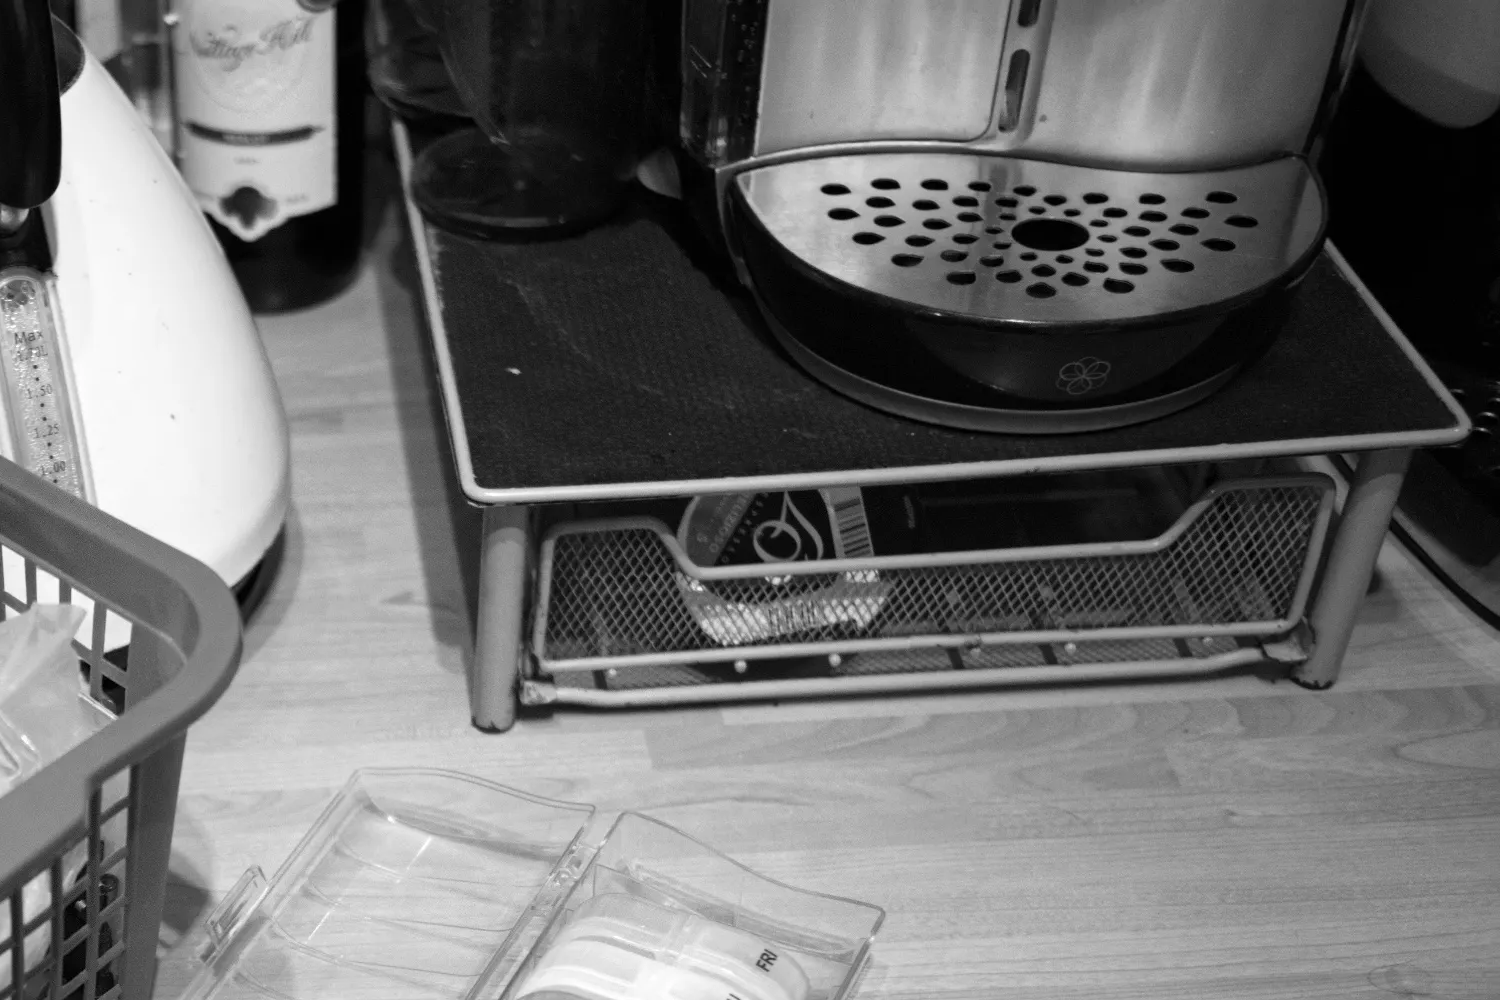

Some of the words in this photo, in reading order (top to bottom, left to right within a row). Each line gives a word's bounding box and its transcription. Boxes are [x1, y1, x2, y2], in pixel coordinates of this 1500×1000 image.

[15, 330, 44, 344] Max
[27, 384, 53, 399] 1.50
[33, 425, 60, 439] 1.25
[41, 461, 66, 476] 1.00
[754, 948, 780, 972] FRI
